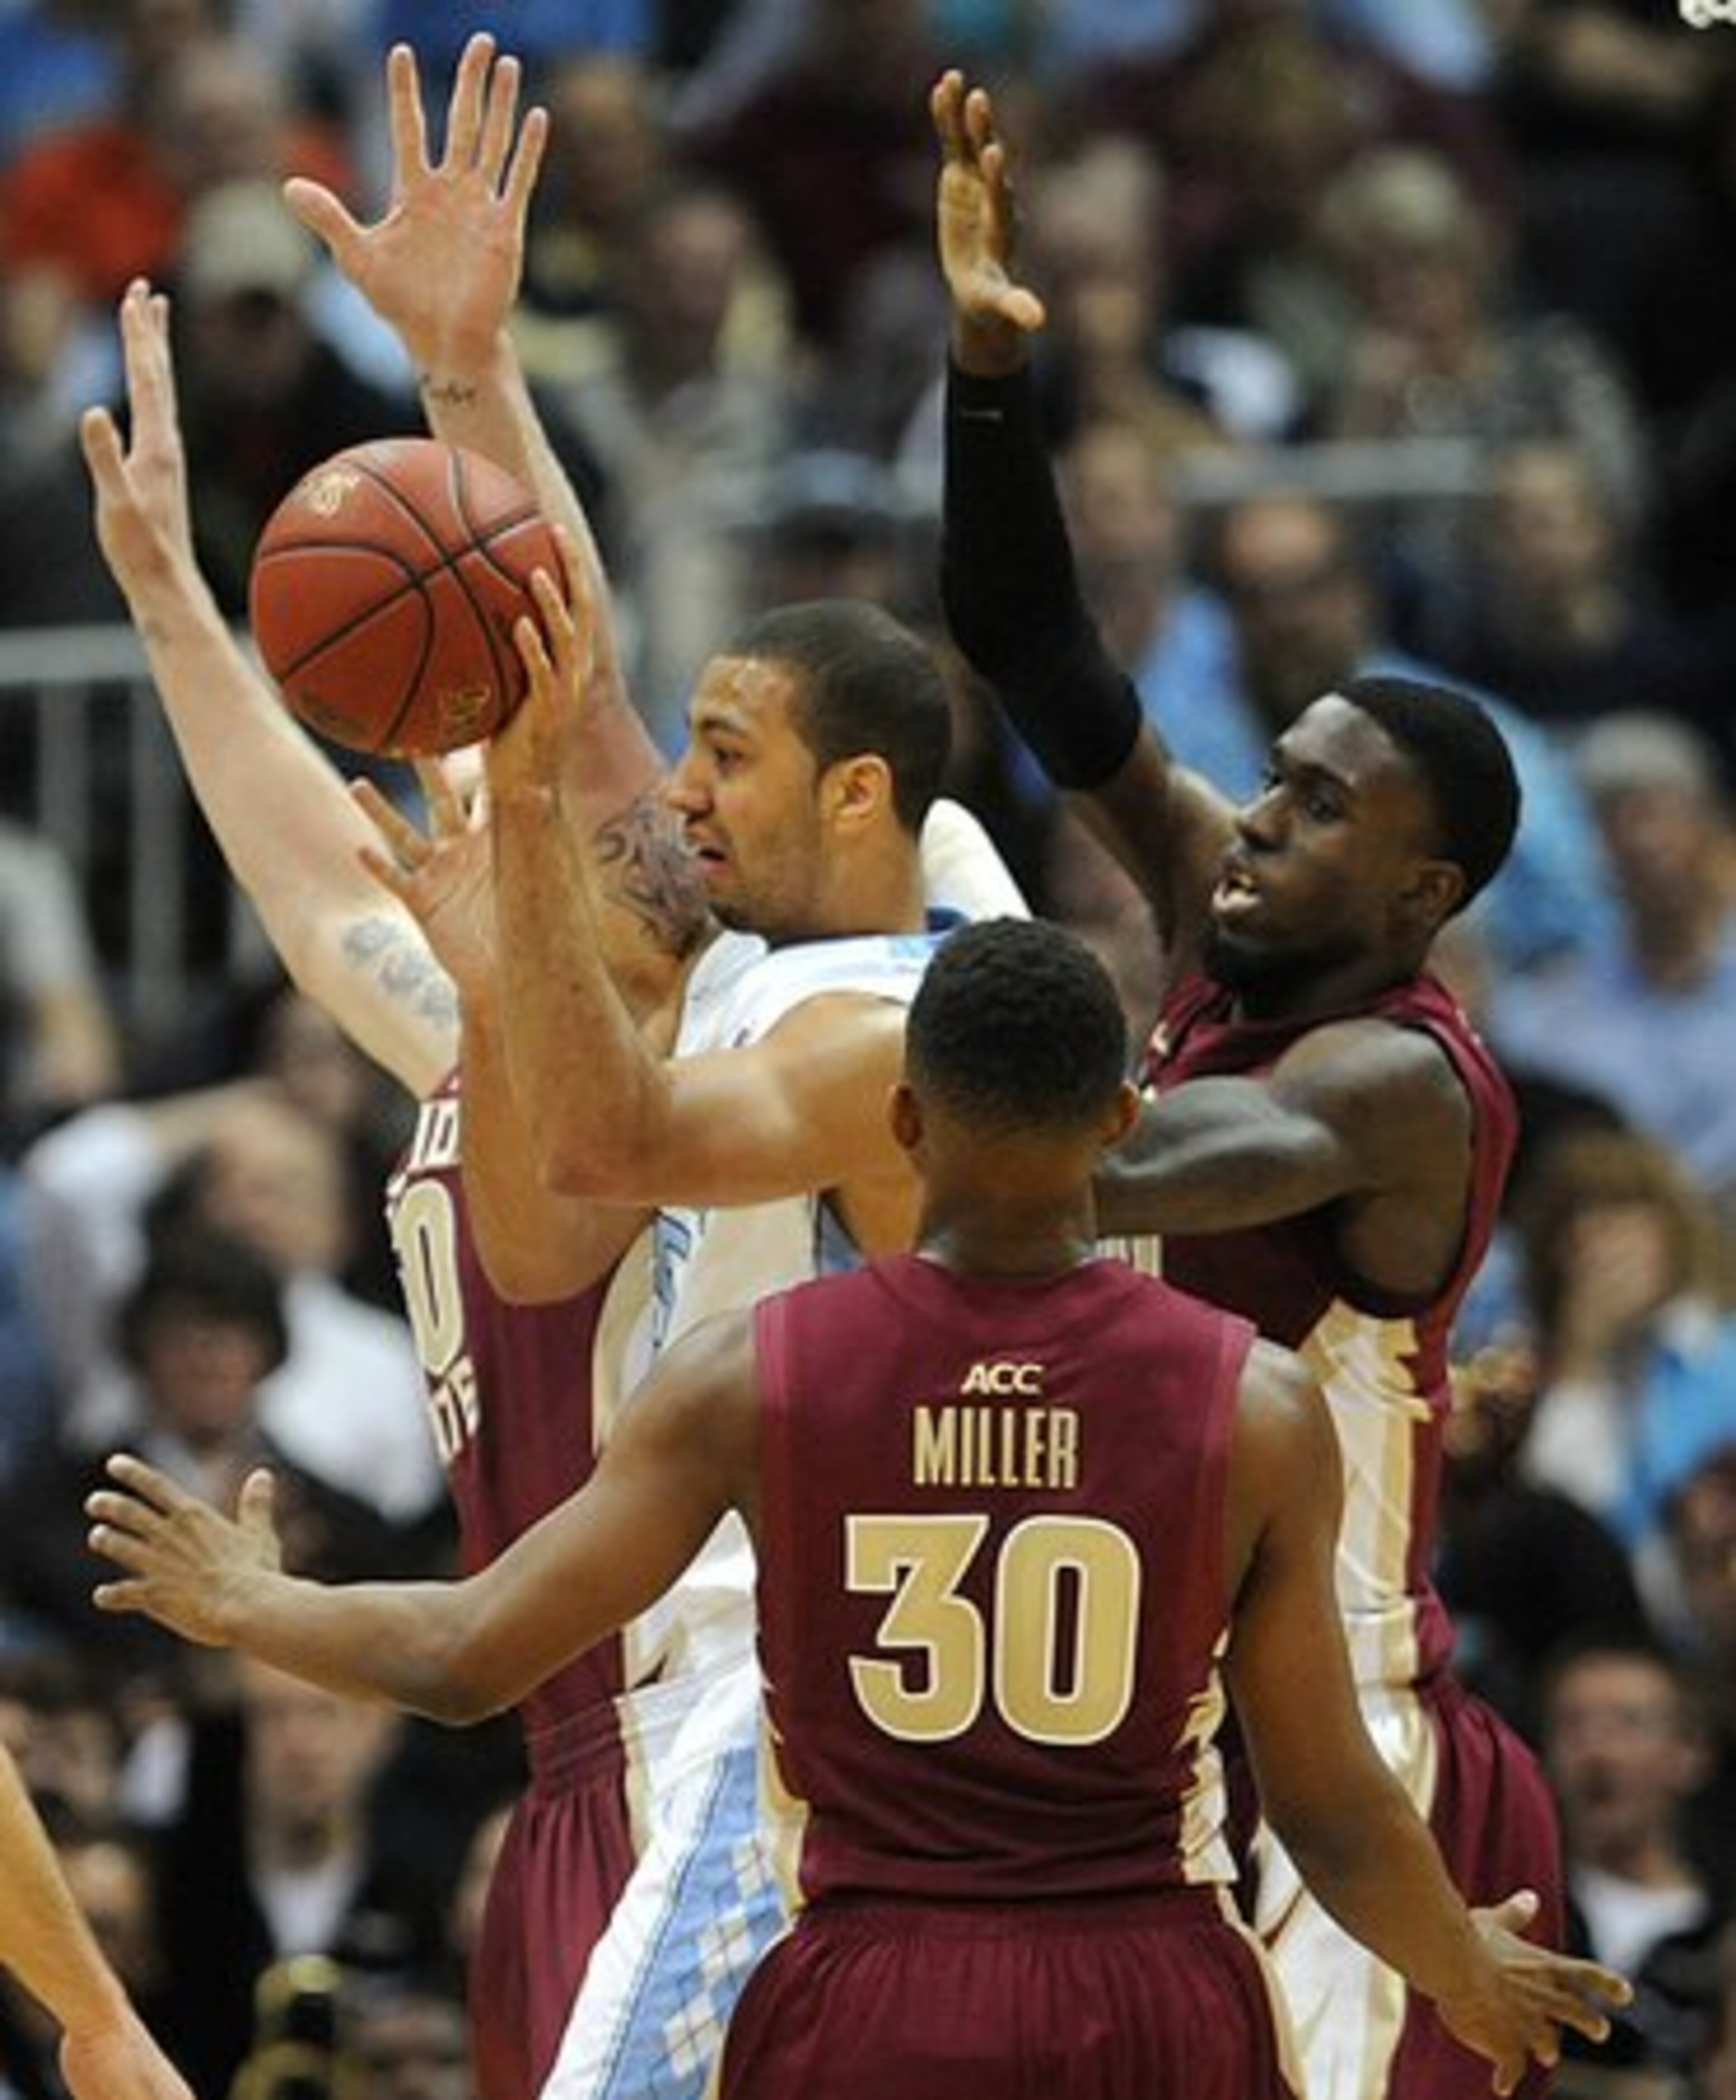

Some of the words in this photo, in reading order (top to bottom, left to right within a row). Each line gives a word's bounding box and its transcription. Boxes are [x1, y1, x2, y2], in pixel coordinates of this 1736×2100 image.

[960, 1364, 1045, 1395] ACC
[914, 1406, 1078, 1488] MILLER
[844, 1514, 1141, 1745] 30
